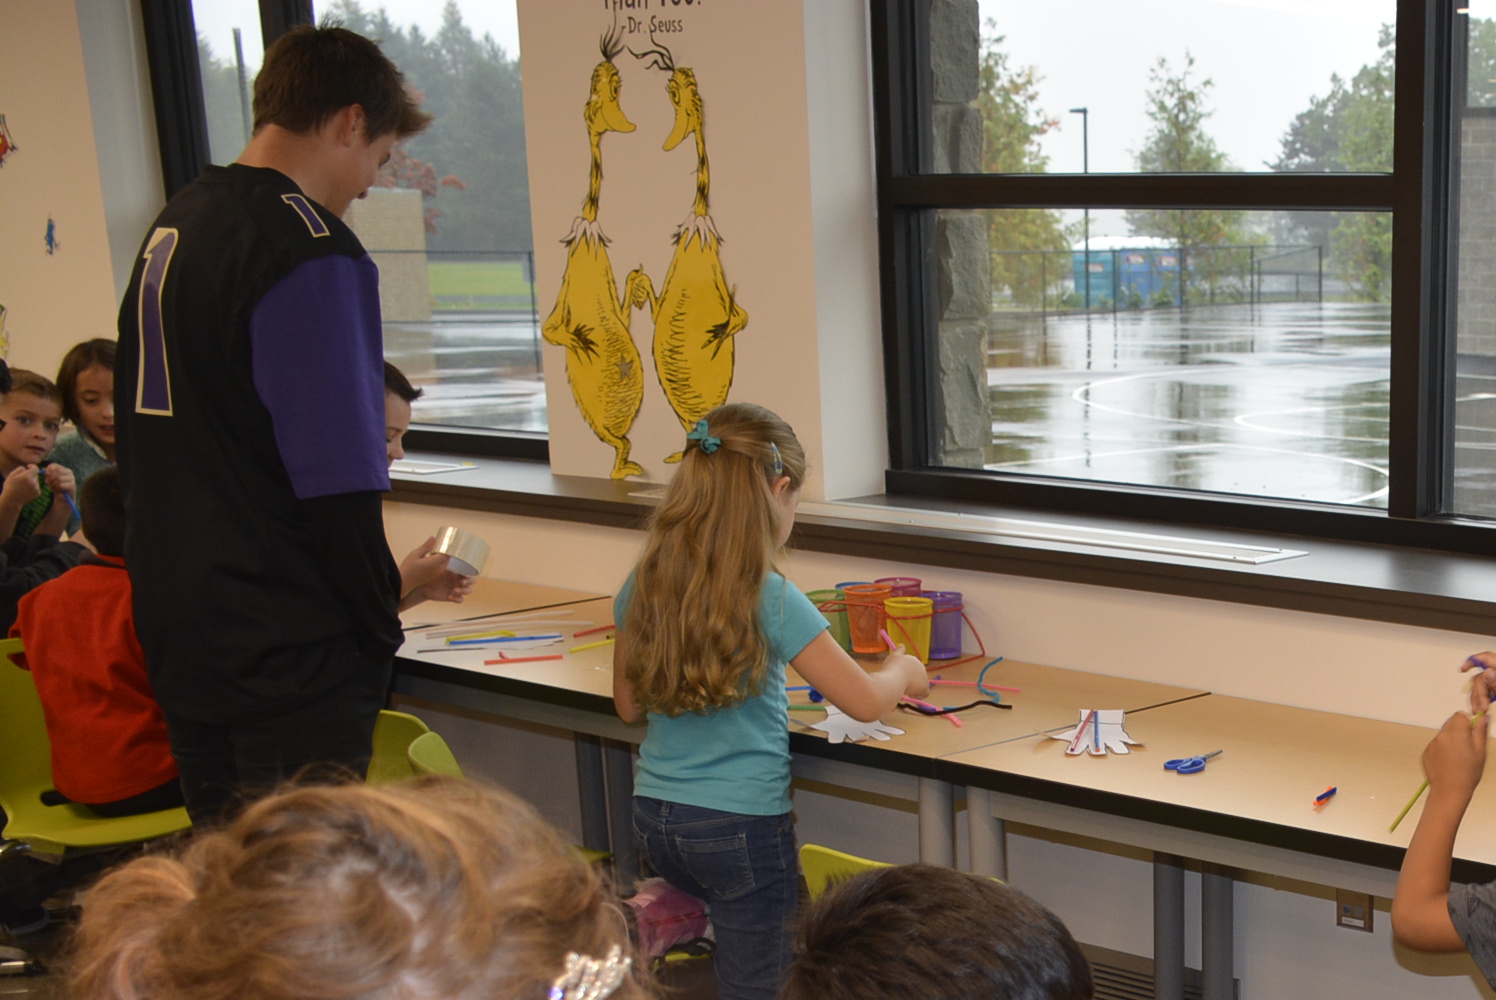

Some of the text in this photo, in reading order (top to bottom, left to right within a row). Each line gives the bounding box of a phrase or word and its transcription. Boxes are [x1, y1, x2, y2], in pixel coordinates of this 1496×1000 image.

[649, 14, 684, 34] Seuss
[280, 193, 331, 238] 1
[135, 227, 179, 417] 1
